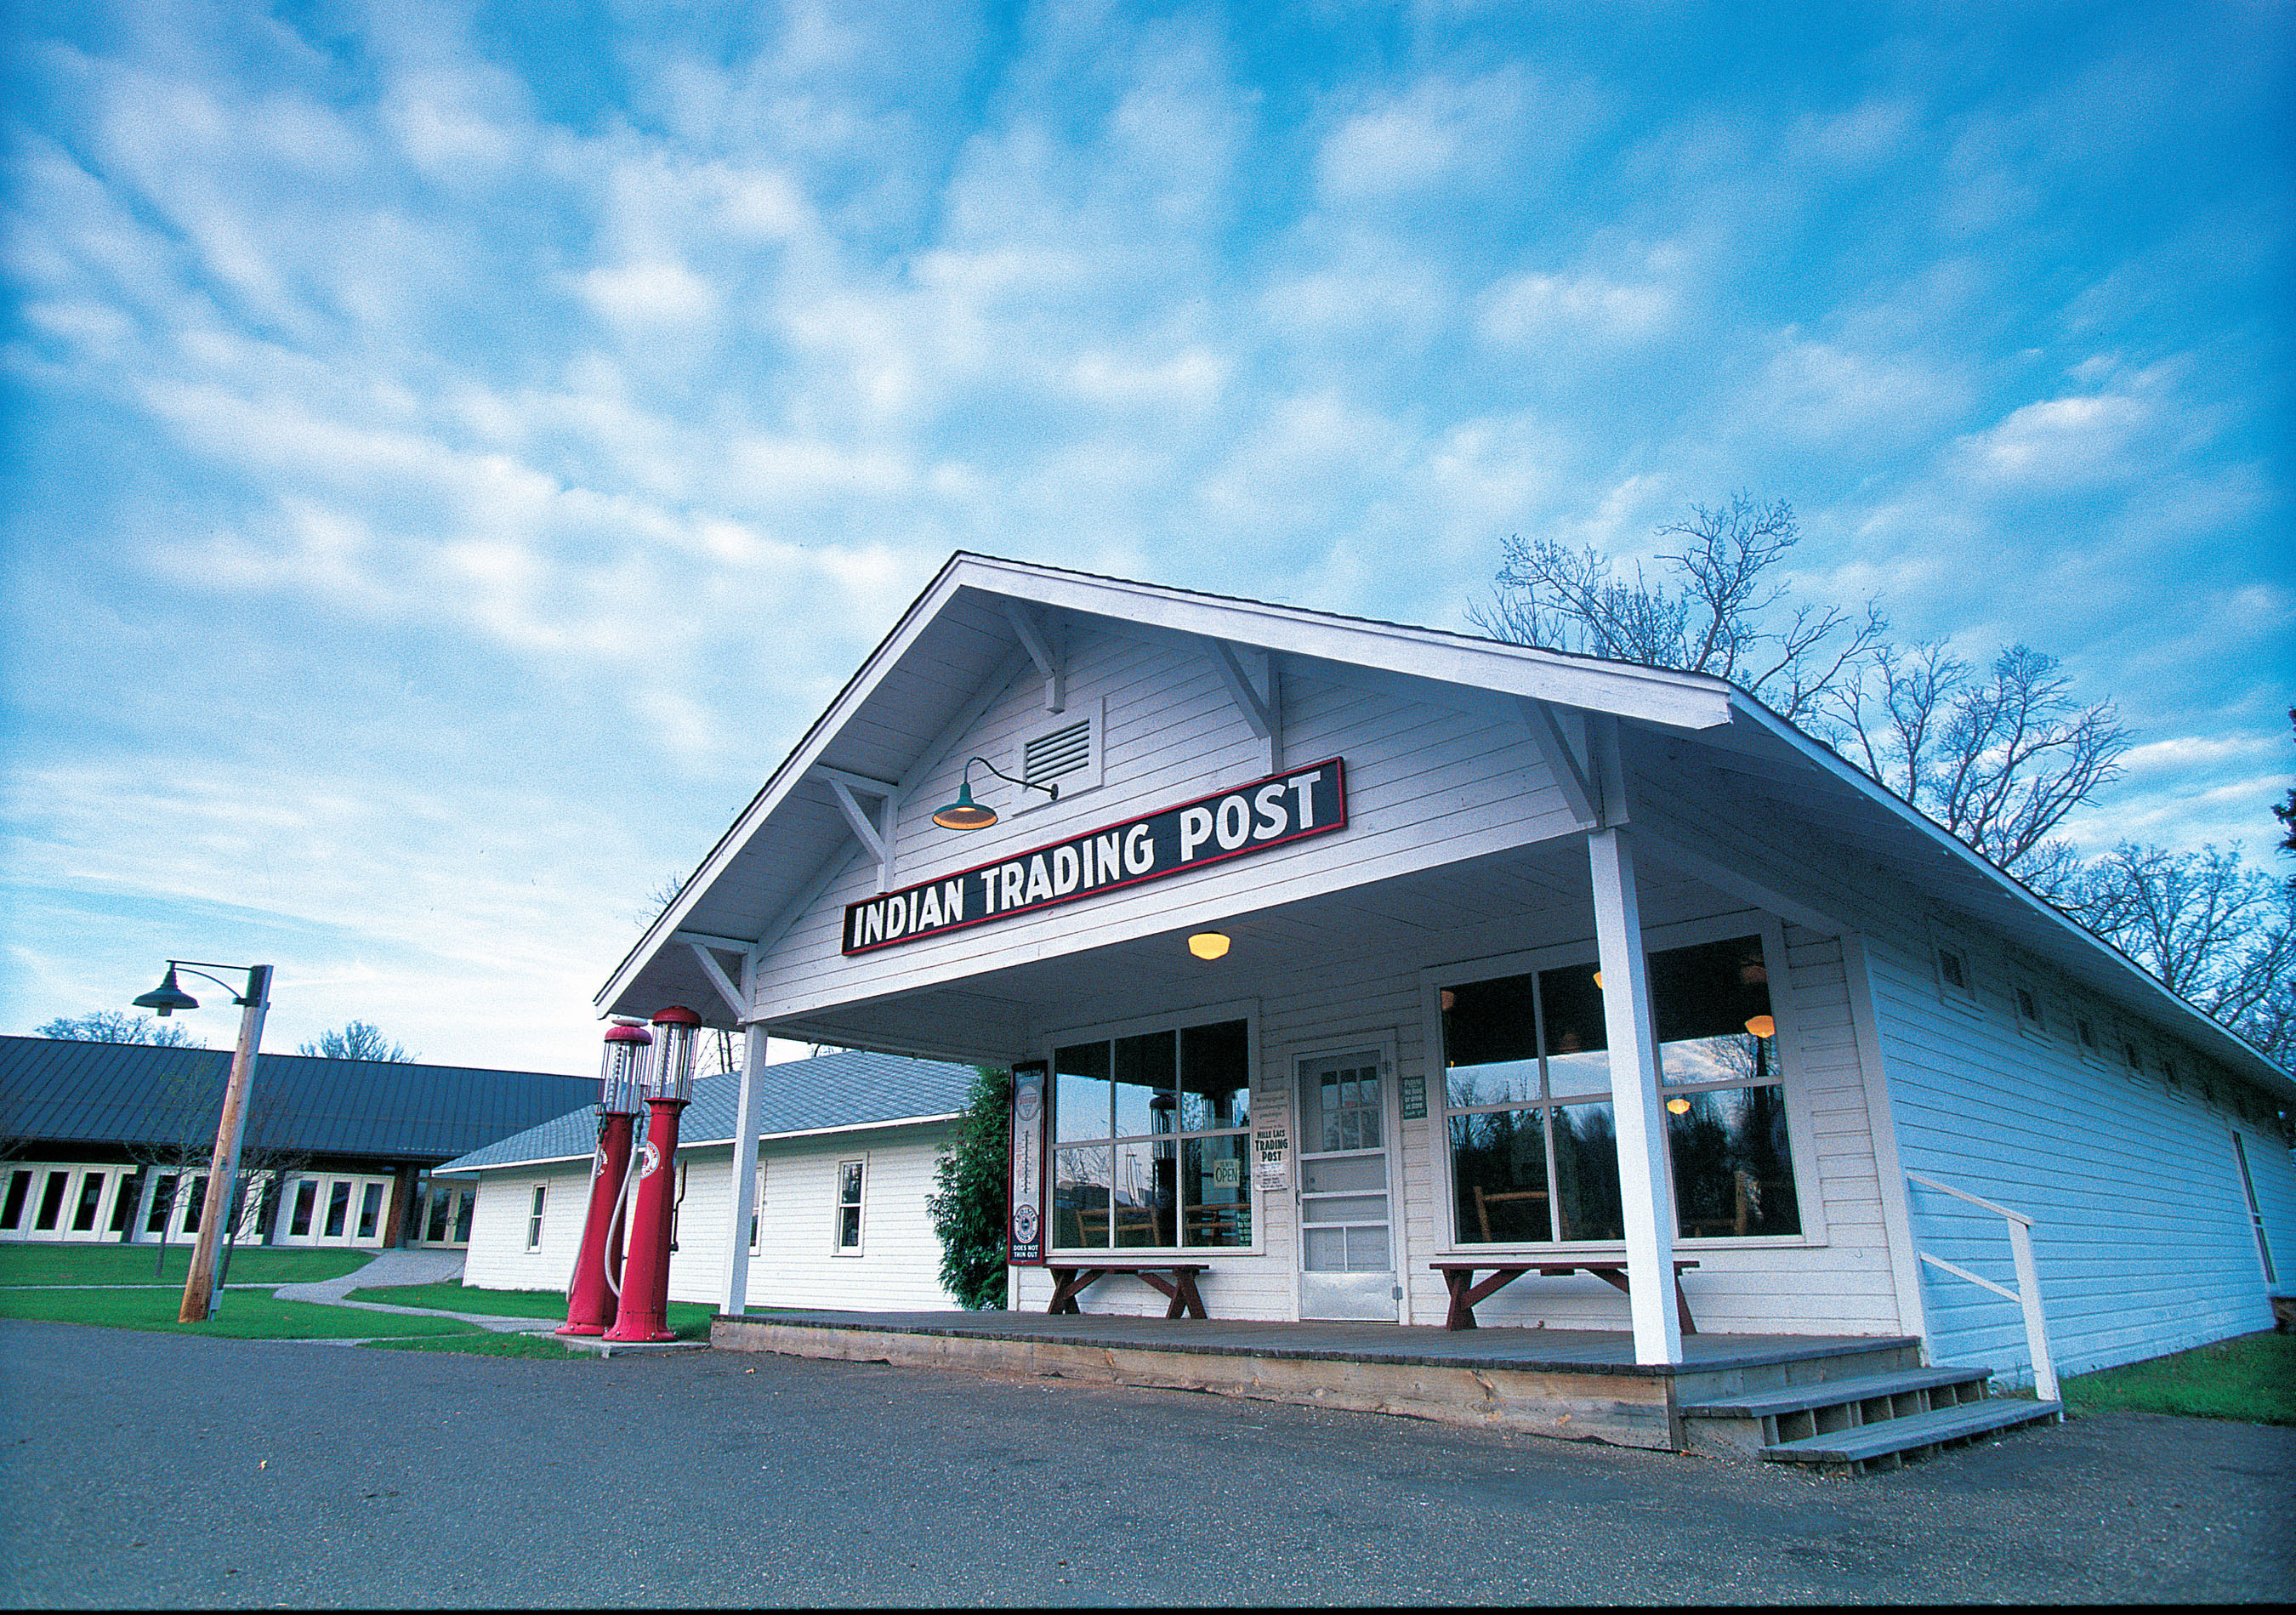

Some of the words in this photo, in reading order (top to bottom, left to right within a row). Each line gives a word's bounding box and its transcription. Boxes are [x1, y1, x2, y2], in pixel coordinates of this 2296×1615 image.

[853, 879, 964, 948] INDIAN
[980, 823, 1156, 914] TRADING
[1179, 771, 1321, 862] POST
[1255, 1139, 1288, 1152] TRADING
[1262, 1151, 1282, 1163] POST
[1216, 1167, 1238, 1183] OPEN
